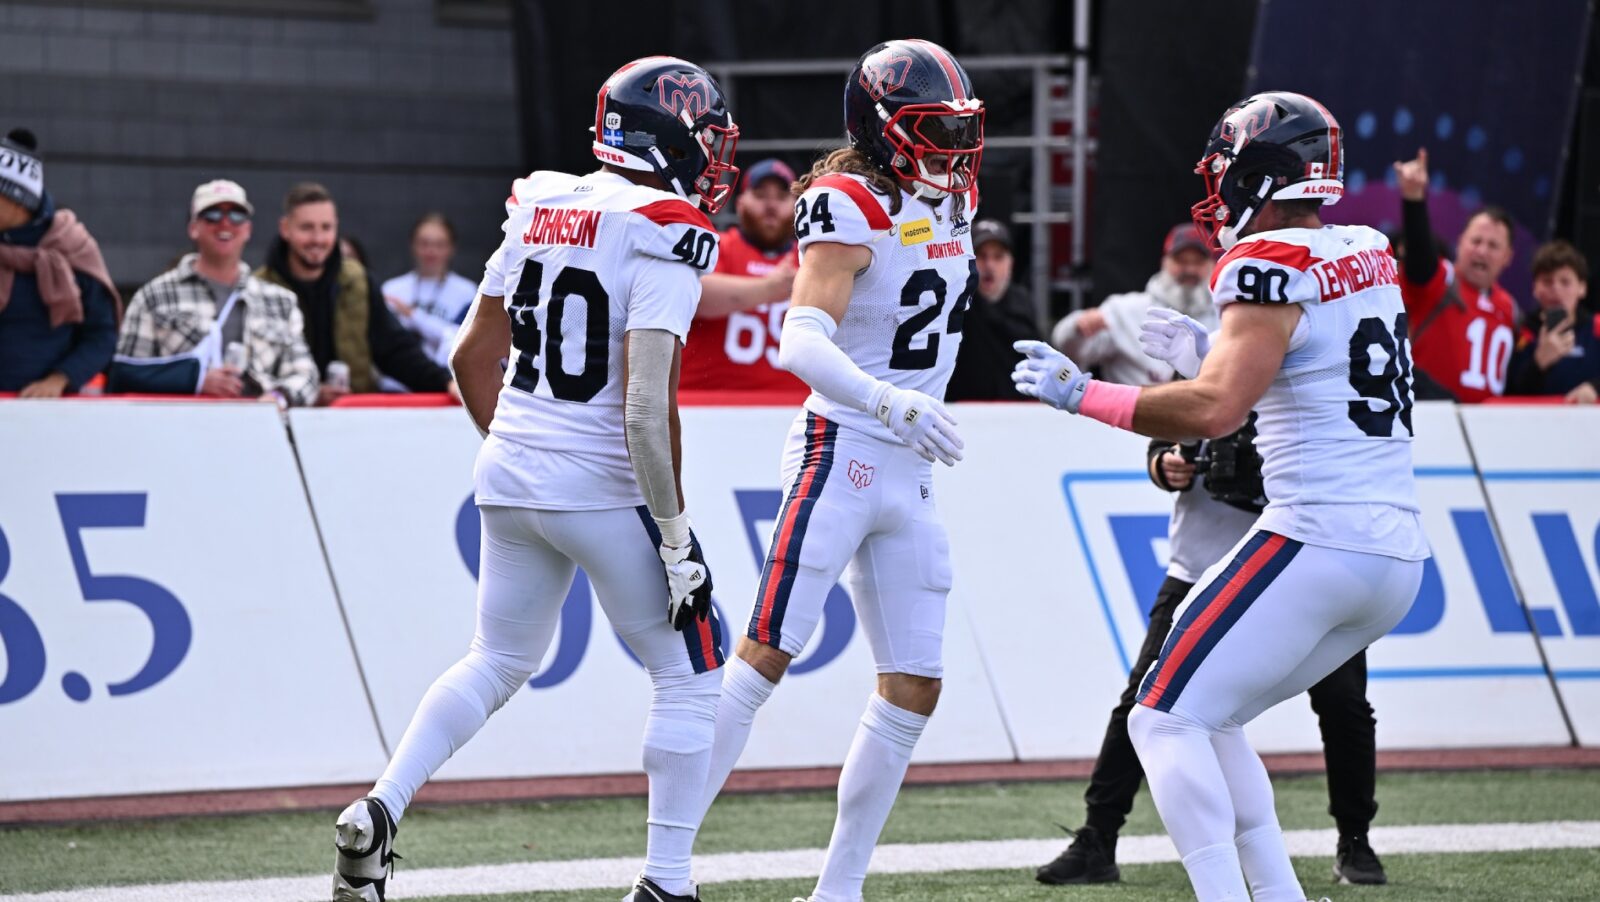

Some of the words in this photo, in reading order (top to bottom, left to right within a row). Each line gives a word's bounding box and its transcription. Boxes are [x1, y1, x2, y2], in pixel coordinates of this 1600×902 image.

[523, 206, 601, 249] JOHNSON
[794, 192, 836, 239] 24
[672, 227, 717, 271] 40
[926, 239, 965, 260] MONTRÉAL
[1235, 265, 1290, 304] 90
[507, 258, 610, 404] 40
[1460, 316, 1514, 396] 10
